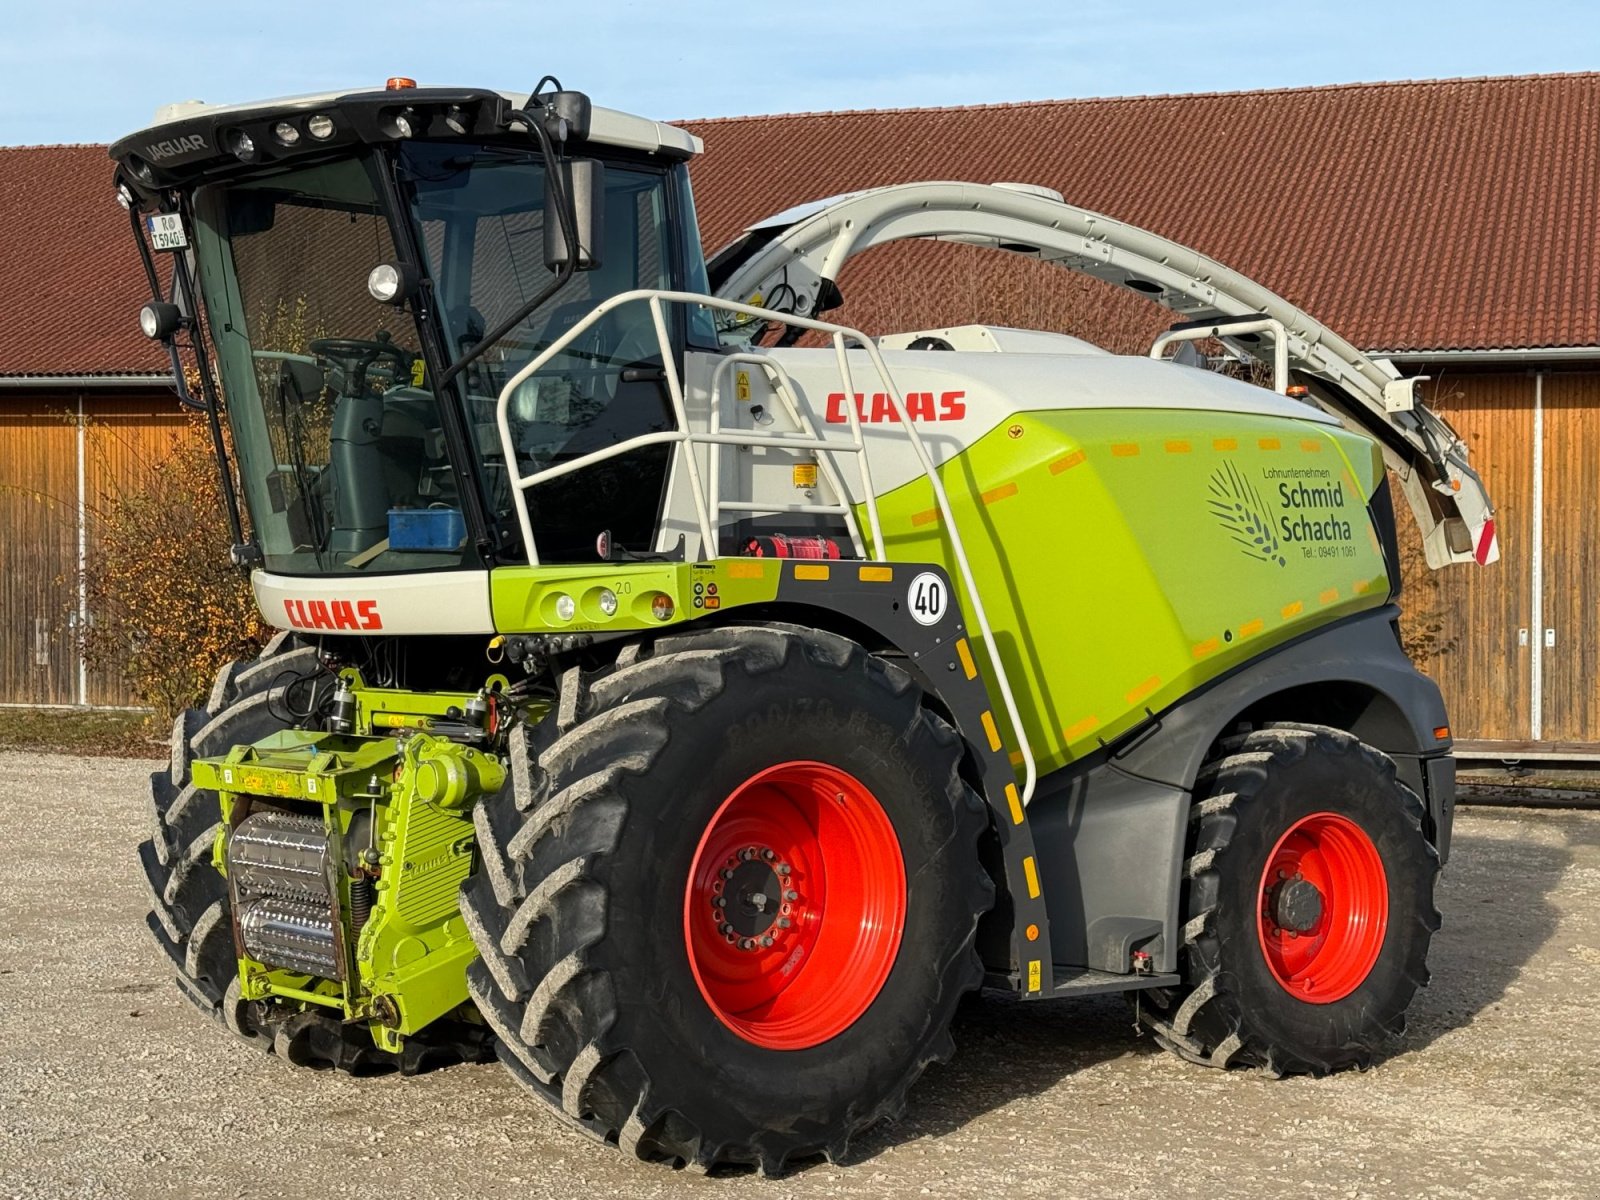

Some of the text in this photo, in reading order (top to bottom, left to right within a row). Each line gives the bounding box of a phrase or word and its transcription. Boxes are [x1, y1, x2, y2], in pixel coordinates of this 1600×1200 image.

[145, 134, 208, 161] JAGUAR
[161, 217, 169, 231] R
[826, 391, 966, 423] CLAAS
[1262, 467, 1331, 479] Lohnunternehmen
[1278, 481, 1344, 508] Schmid
[1280, 514, 1352, 542] Schacha
[1301, 546, 1357, 558] Tel.: 09491 1061
[615, 581, 632, 595] 20
[915, 582, 940, 615] 40
[283, 599, 383, 630] CLAAS
